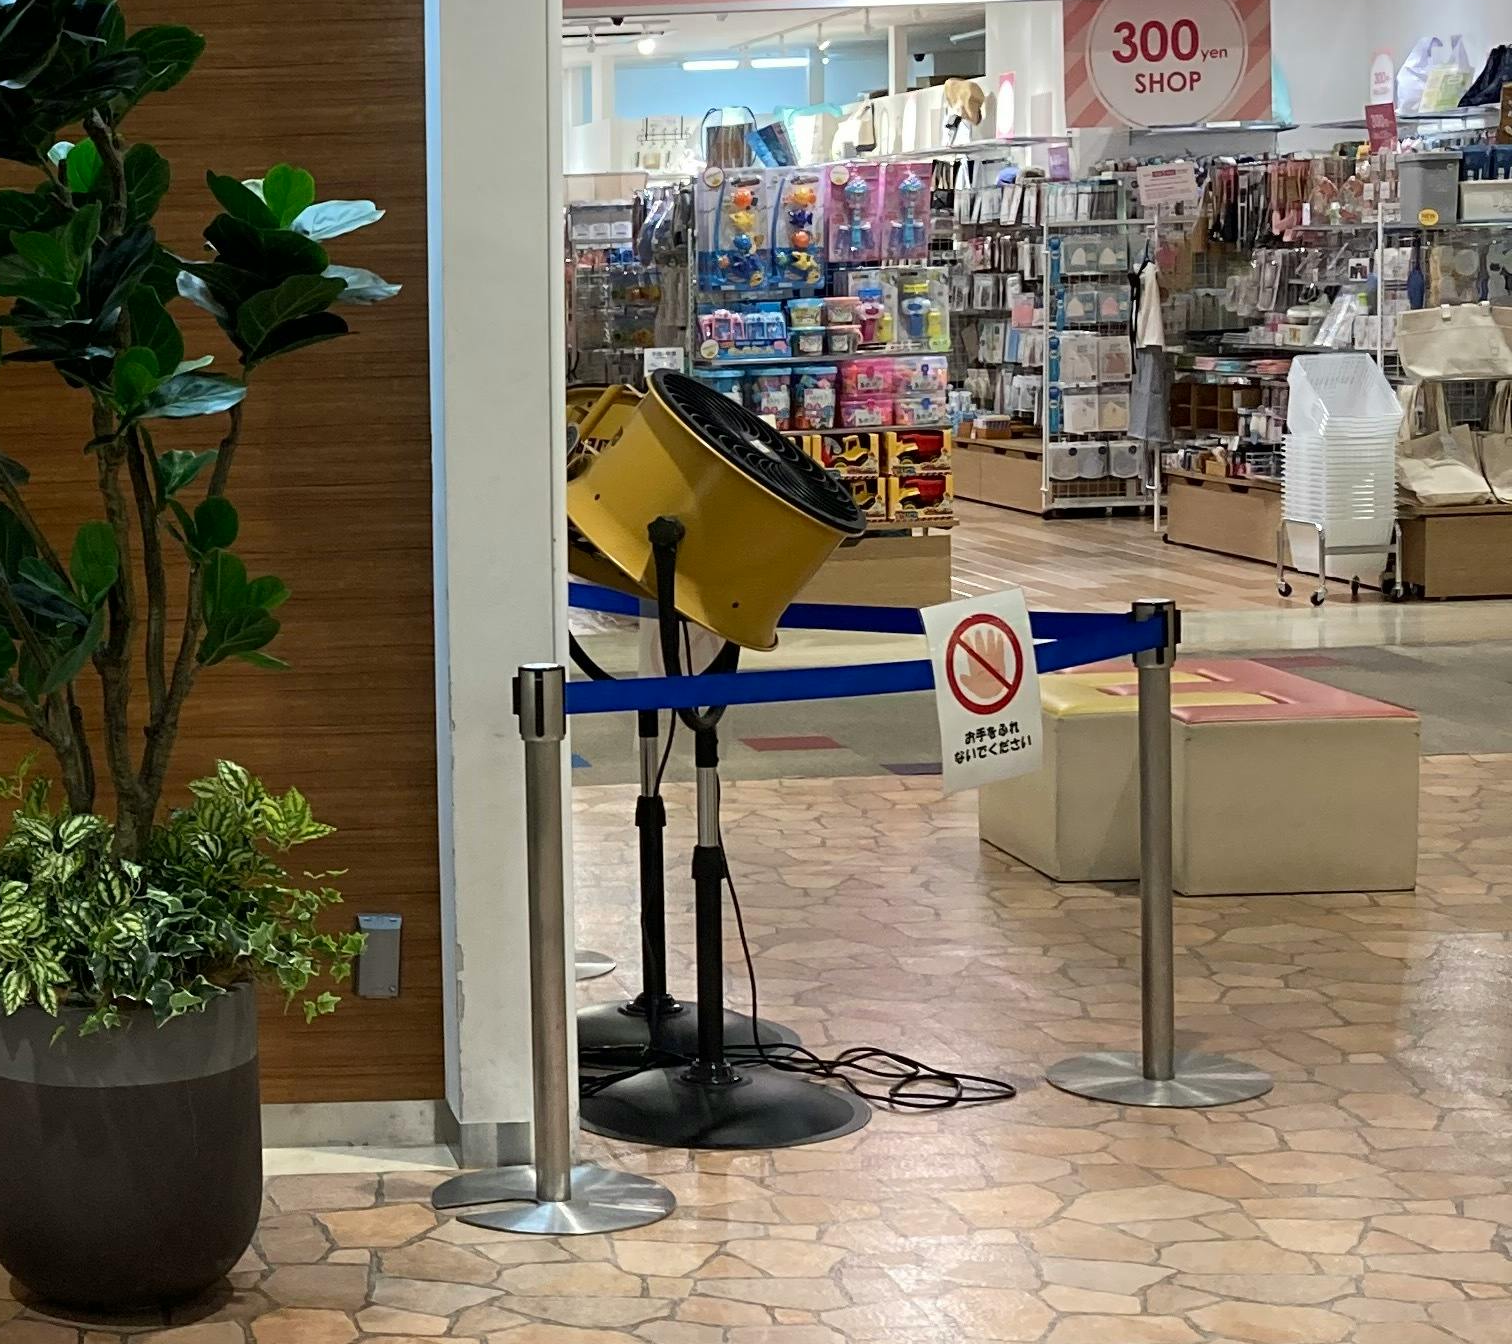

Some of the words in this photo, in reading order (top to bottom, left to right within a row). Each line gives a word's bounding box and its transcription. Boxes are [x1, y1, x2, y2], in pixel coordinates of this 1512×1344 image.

[1111, 18, 1200, 64] 300
[1200, 47, 1229, 63] yen
[1134, 71, 1202, 94] SHOP
[964, 720, 1020, 744] お手をふれ
[953, 735, 1033, 765] ないでください
